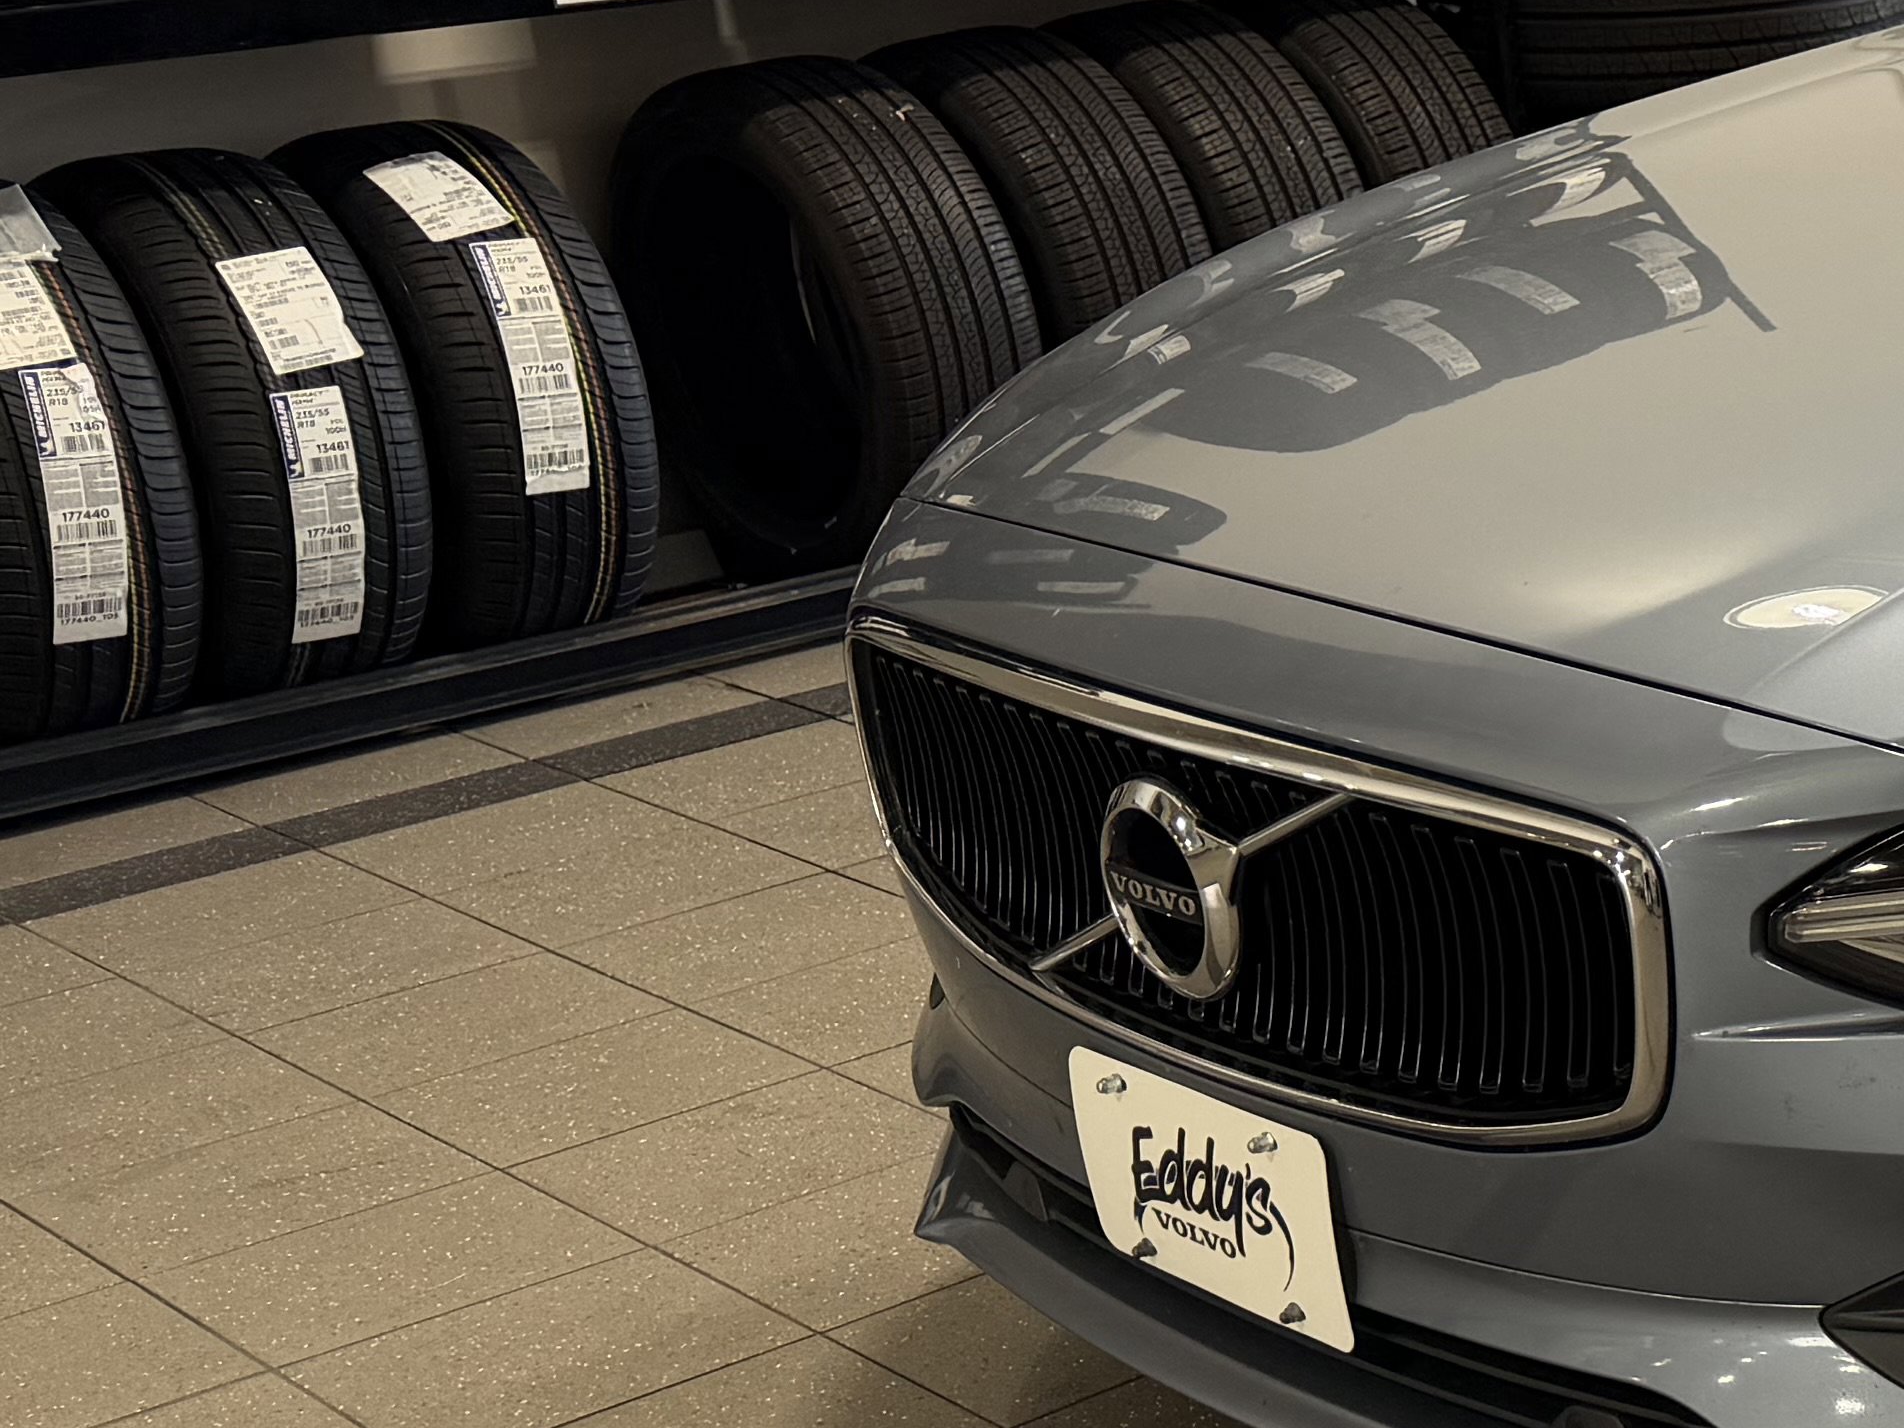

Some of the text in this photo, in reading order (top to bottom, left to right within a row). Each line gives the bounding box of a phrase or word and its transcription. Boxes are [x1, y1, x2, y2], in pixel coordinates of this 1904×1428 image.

[521, 362, 565, 376] 177440
[23, 374, 49, 439] MICHELIN
[69, 420, 106, 433] 13461
[274, 398, 299, 460] MICHELIN
[61, 506, 111, 521] 177440
[306, 523, 351, 539] 177440
[1110, 871, 1196, 916] VOLVO
[1131, 1126, 1273, 1258] Eddy's
[1151, 1207, 1237, 1259] VOLVO
